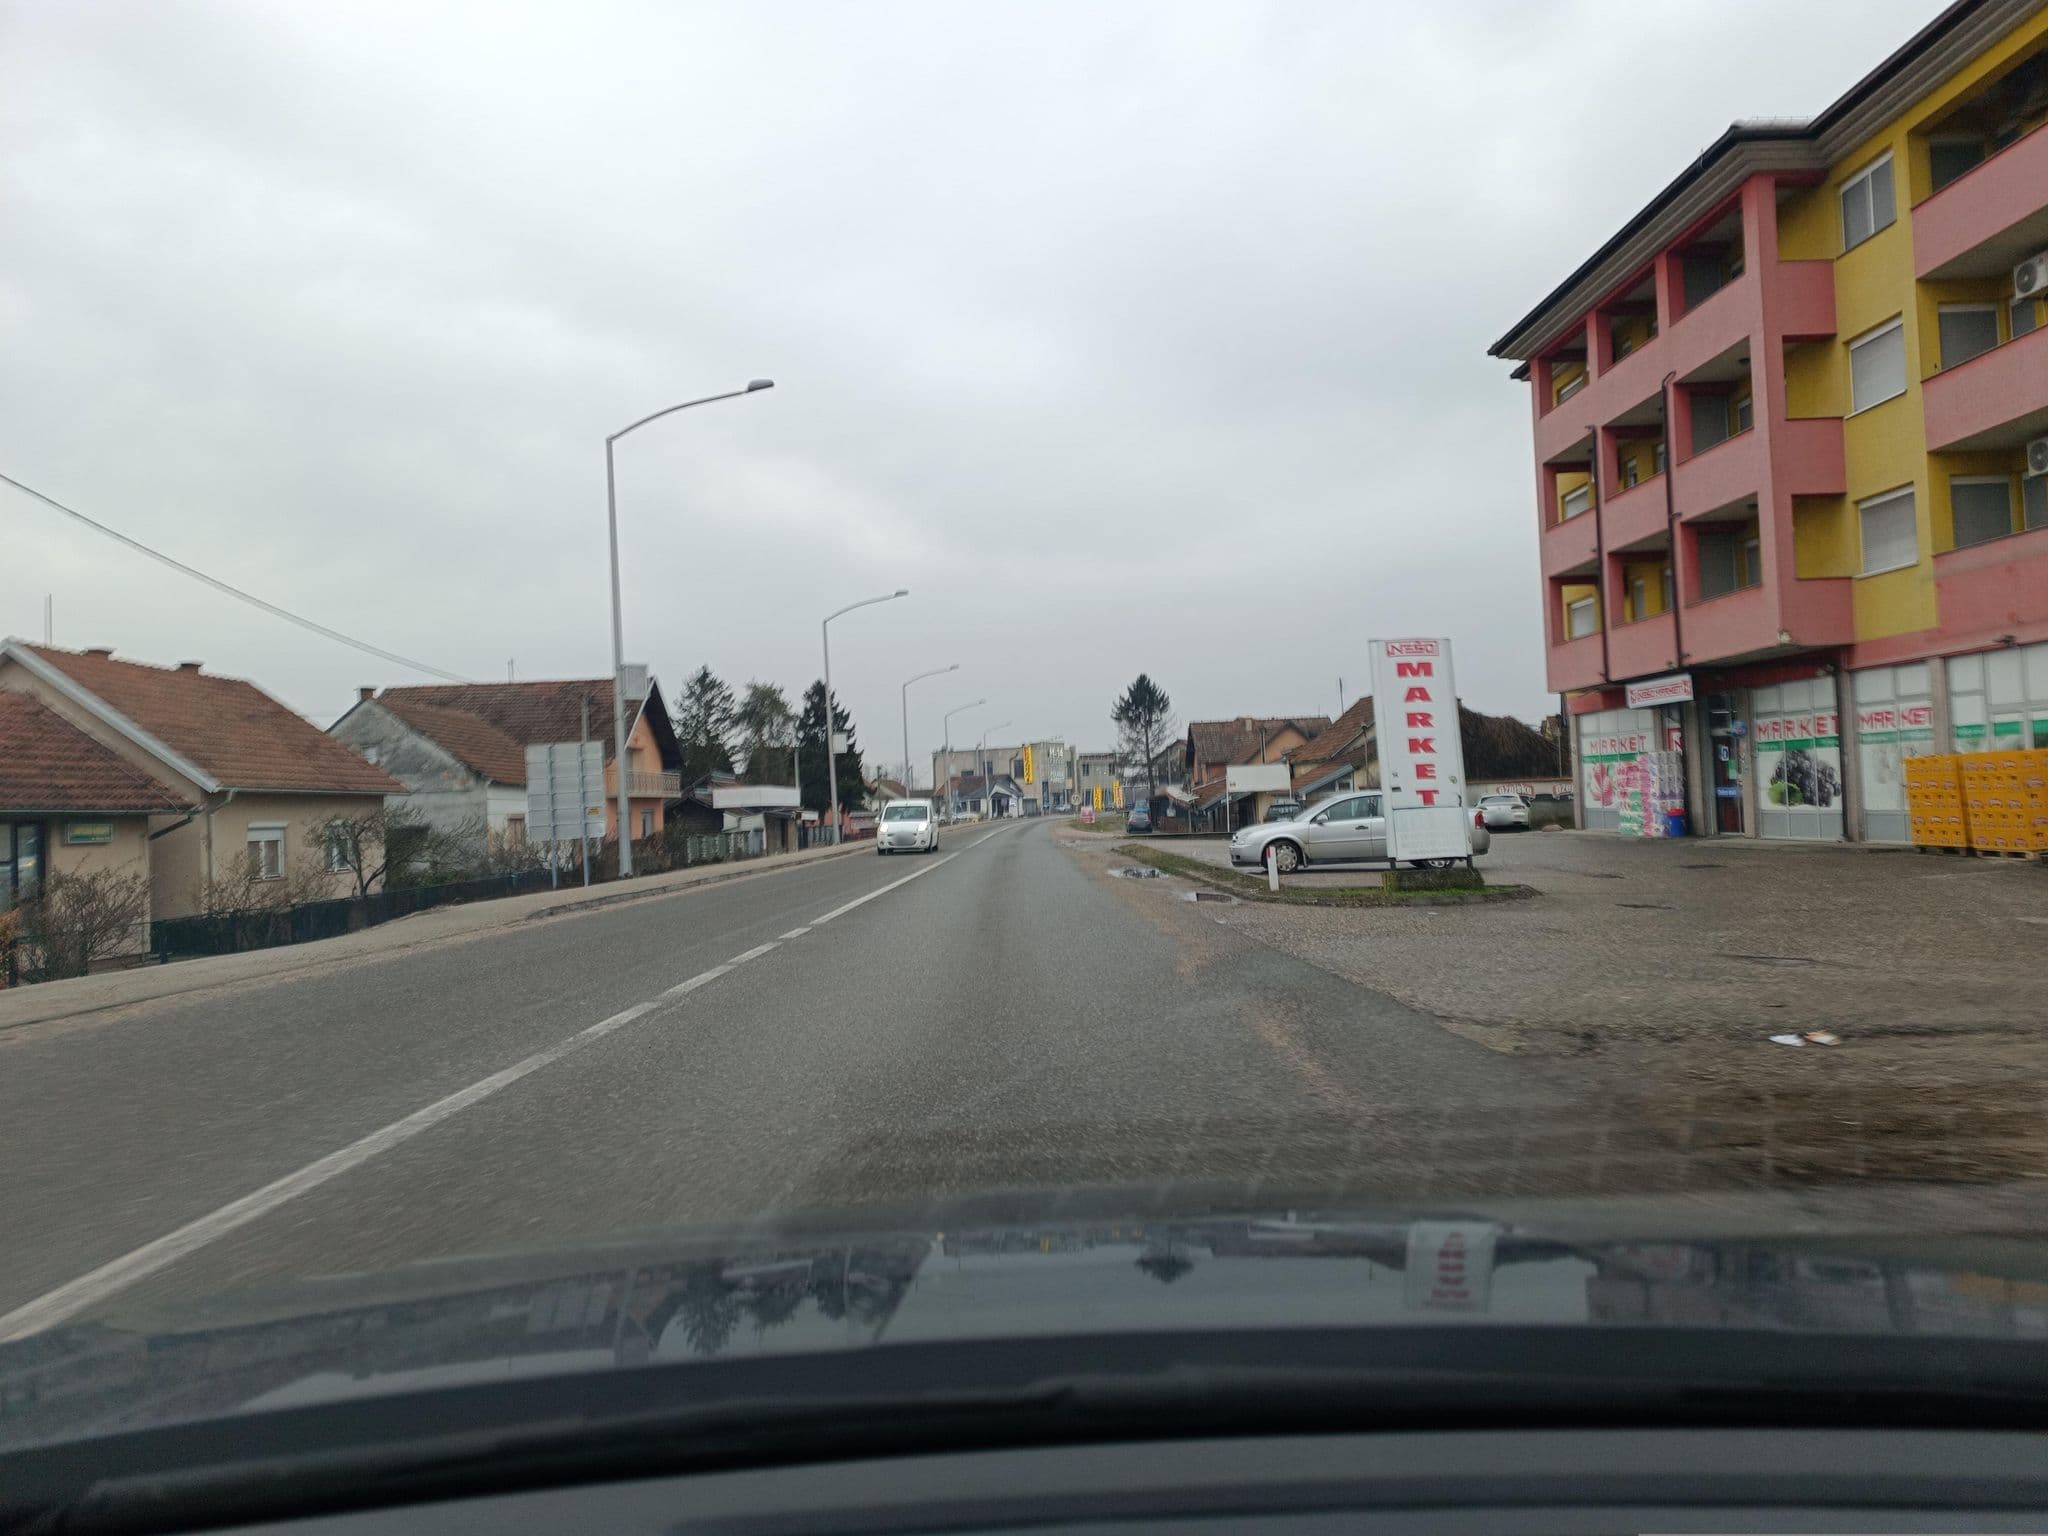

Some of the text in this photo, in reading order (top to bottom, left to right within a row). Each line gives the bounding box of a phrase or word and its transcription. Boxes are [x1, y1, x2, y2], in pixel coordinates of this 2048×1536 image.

[1756, 714, 1840, 741] MARKET
[1856, 706, 1935, 730] MARKET
[1396, 662, 1439, 806] MARKET
[1590, 735, 1647, 753] MARKET
